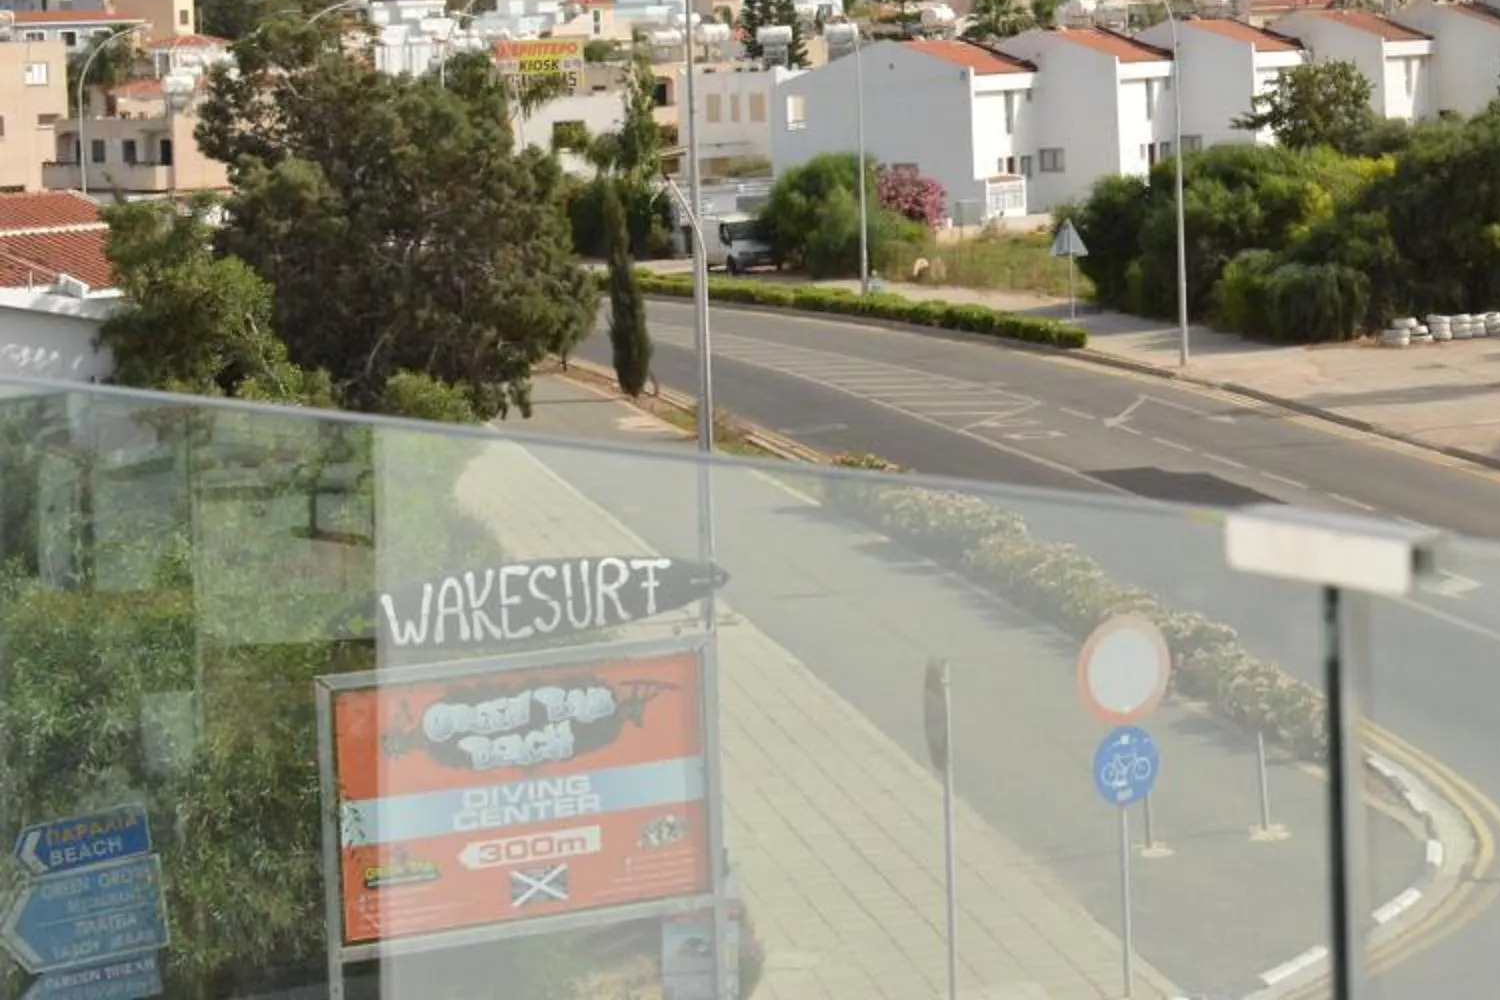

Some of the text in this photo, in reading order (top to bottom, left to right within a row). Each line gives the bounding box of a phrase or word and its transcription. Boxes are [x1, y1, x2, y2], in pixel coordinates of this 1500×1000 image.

[518, 58, 560, 72] KIOSK
[462, 774, 591, 811] DIVING
[453, 793, 600, 831] CENTER
[50, 836, 123, 867] BEACH
[479, 836, 587, 864] 300m
